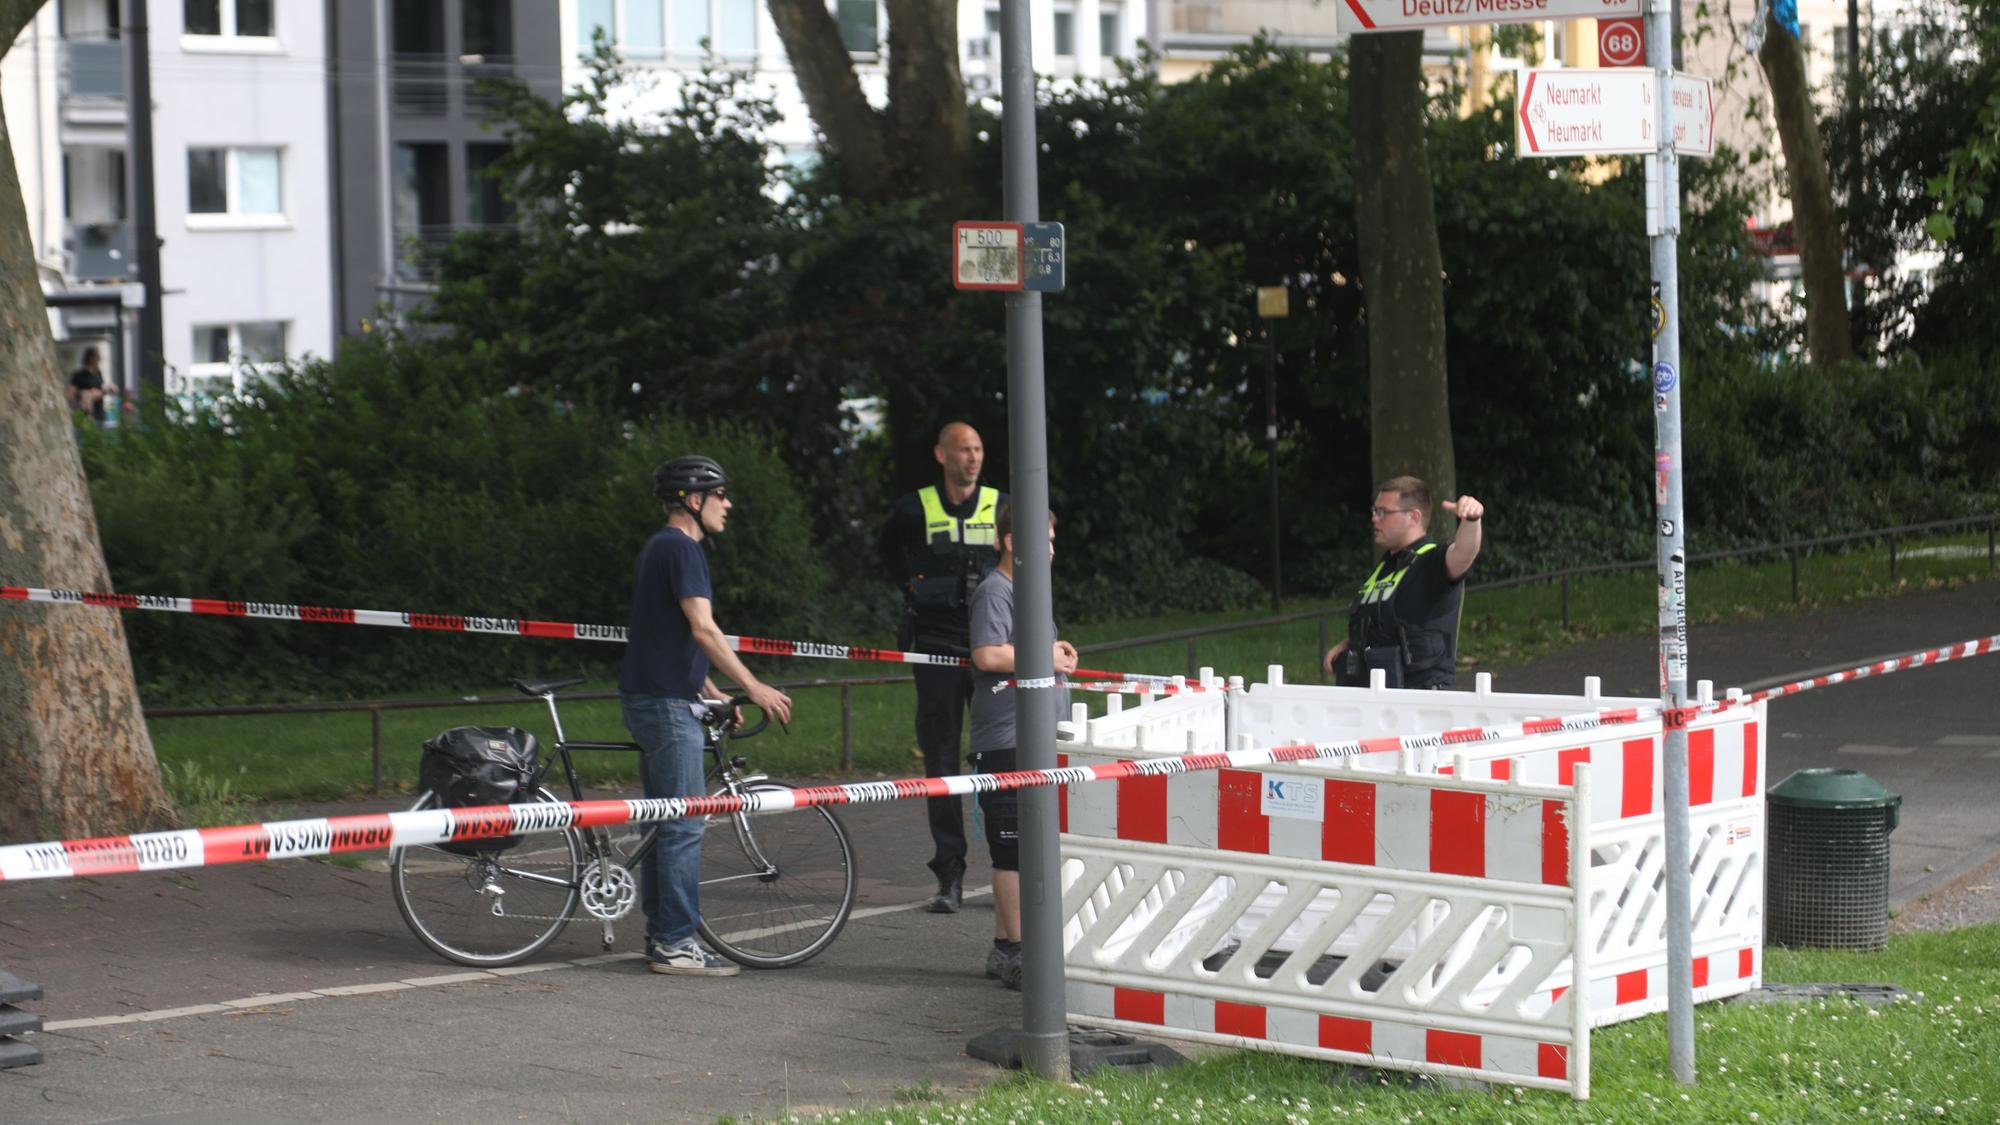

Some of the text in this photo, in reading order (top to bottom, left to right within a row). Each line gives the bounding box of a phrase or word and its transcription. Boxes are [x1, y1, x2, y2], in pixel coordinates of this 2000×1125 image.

[1608, 34, 1633, 53] 68
[1546, 82, 1602, 105] Neumarkt
[1547, 119, 1603, 142] Heumarkt
[977, 229, 1003, 245] 500
[1266, 780, 1319, 804] KTS
